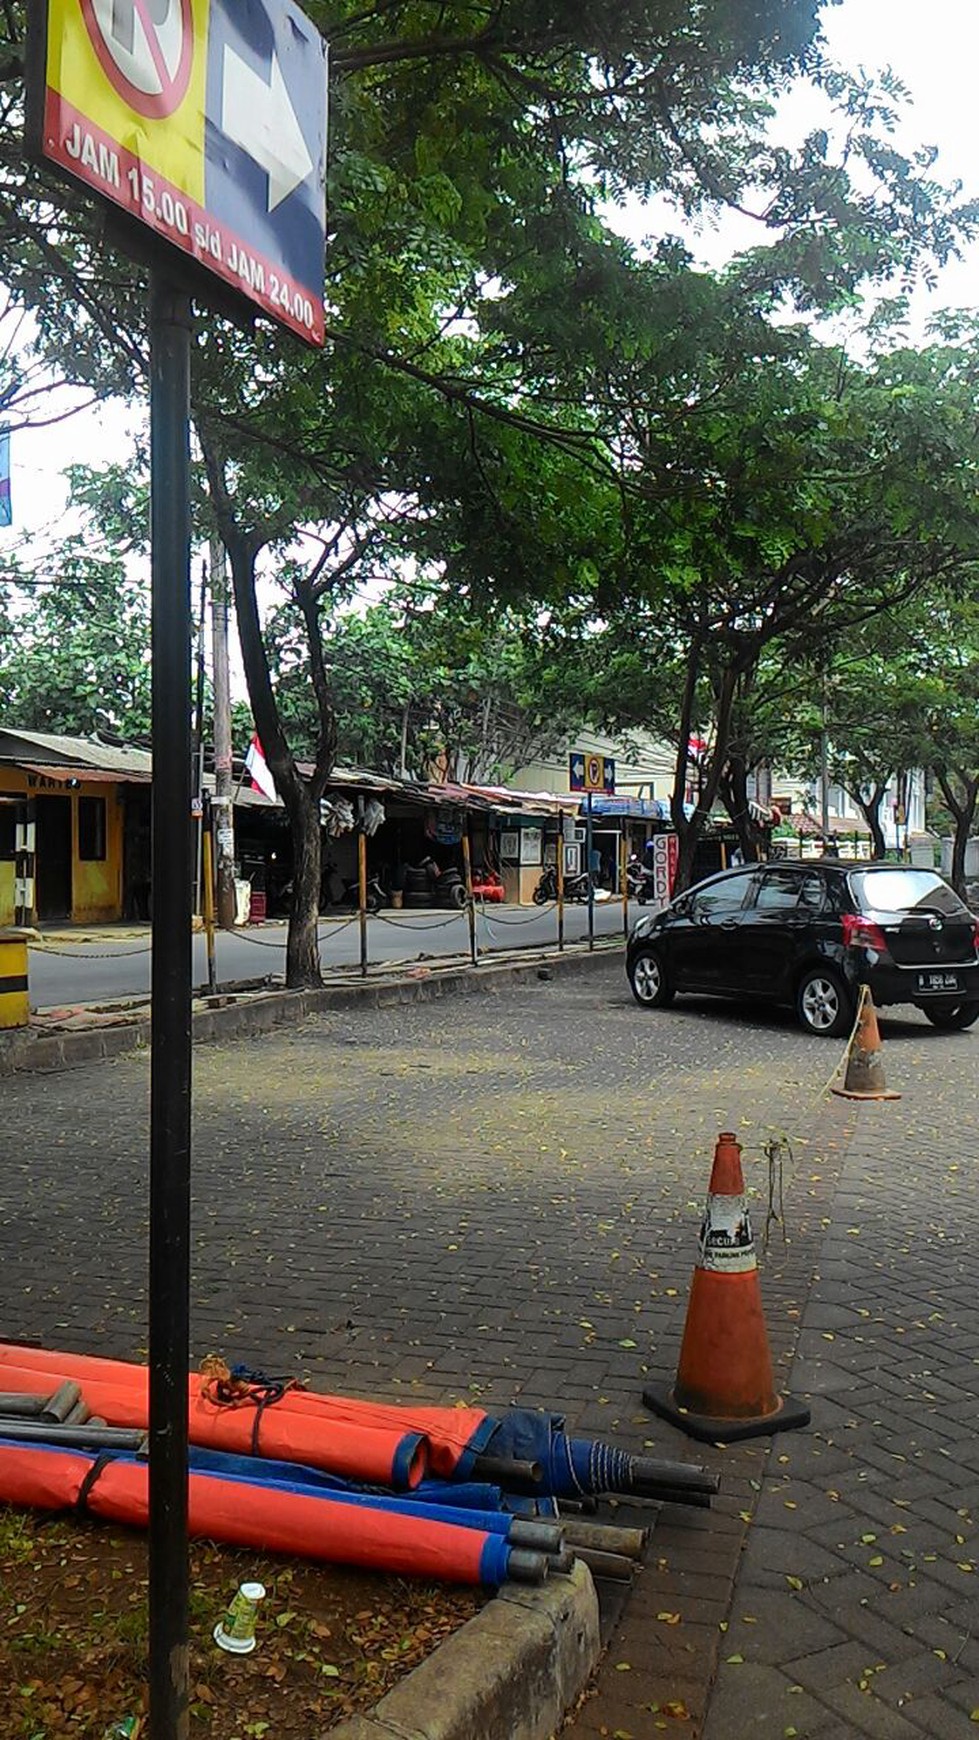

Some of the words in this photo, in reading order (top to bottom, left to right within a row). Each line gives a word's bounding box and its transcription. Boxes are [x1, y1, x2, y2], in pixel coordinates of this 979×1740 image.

[65, 123, 120, 189] JAM
[128, 167, 190, 237] 15.00
[194, 221, 222, 263] s/d
[227, 243, 266, 291] JAM
[269, 273, 314, 328] 24.00
[656, 837, 667, 907] GORDY
